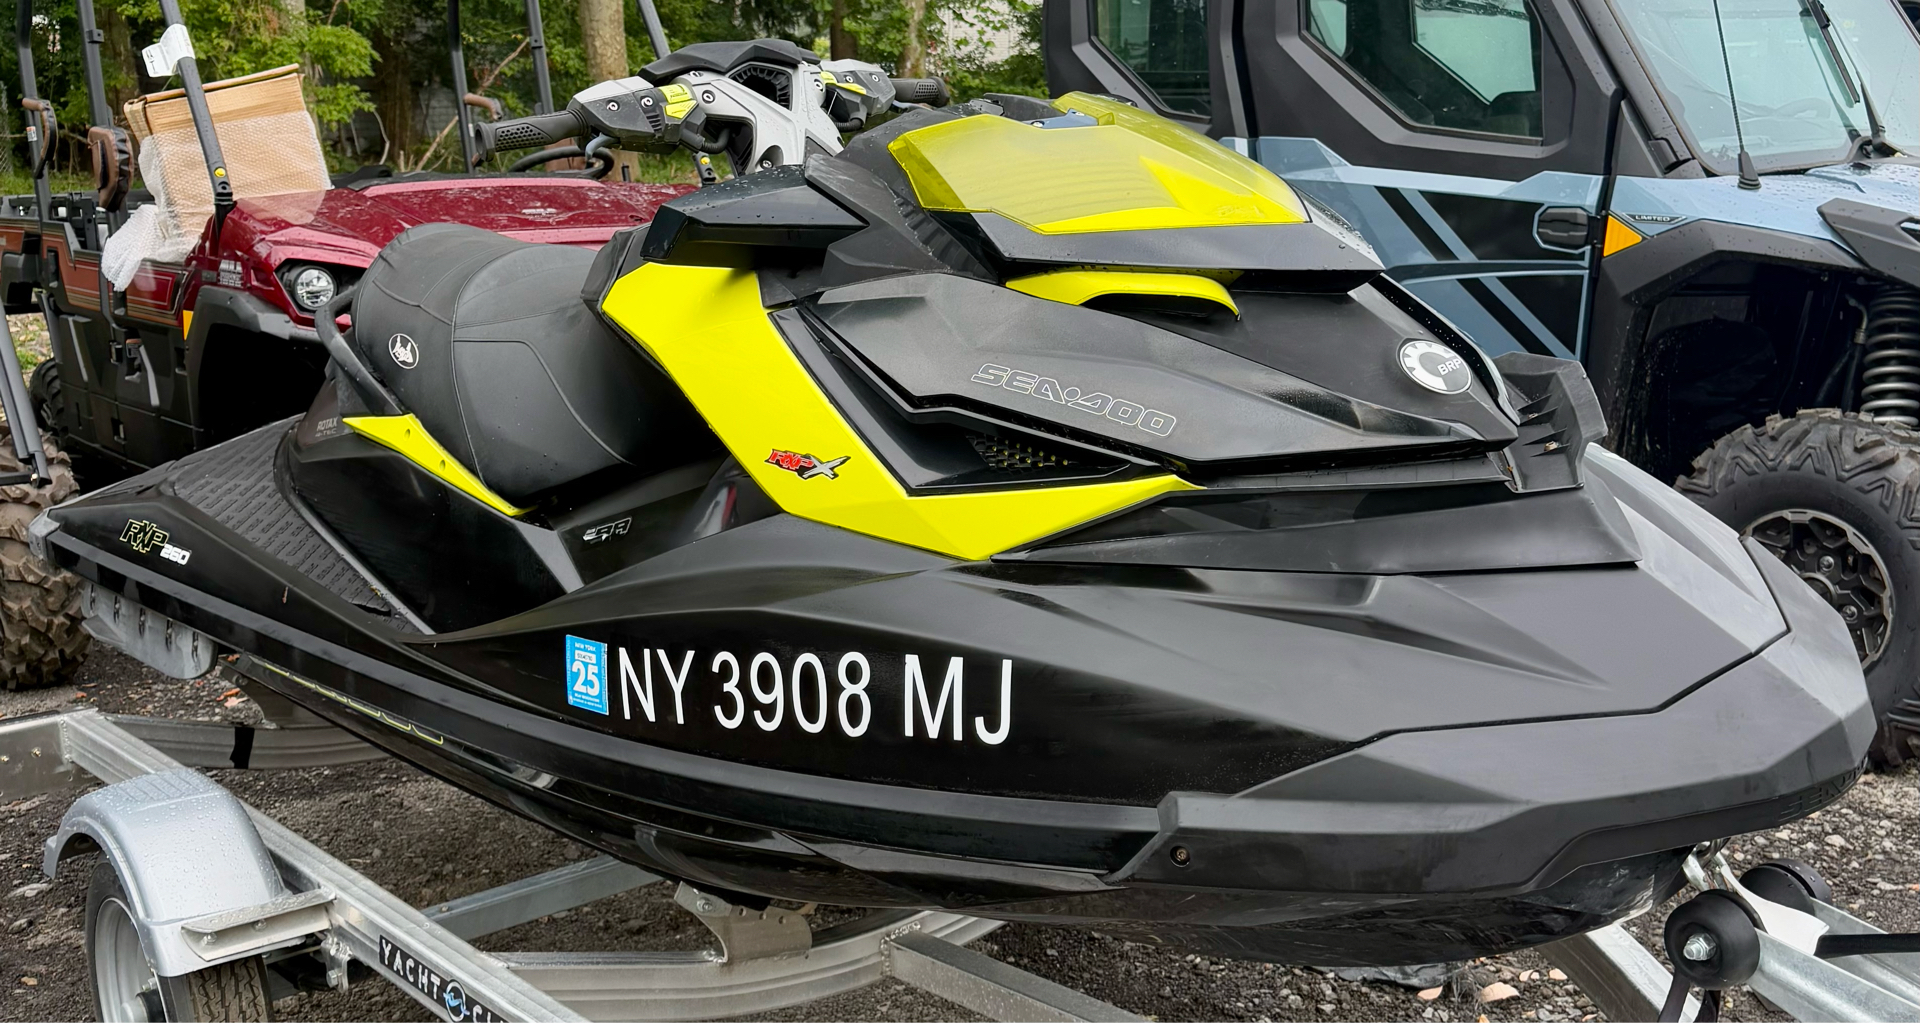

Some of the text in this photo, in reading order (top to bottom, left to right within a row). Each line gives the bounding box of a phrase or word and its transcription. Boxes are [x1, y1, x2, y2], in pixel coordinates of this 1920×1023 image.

[1635, 214, 1671, 222] LIMITED
[1437, 358, 1462, 376] BRP
[316, 416, 339, 432] ROTAX
[160, 543, 191, 566] 260
[571, 660, 601, 697] 25
[618, 646, 1013, 745] NY 3908 MJ
[381, 938, 441, 1000] YACHT
